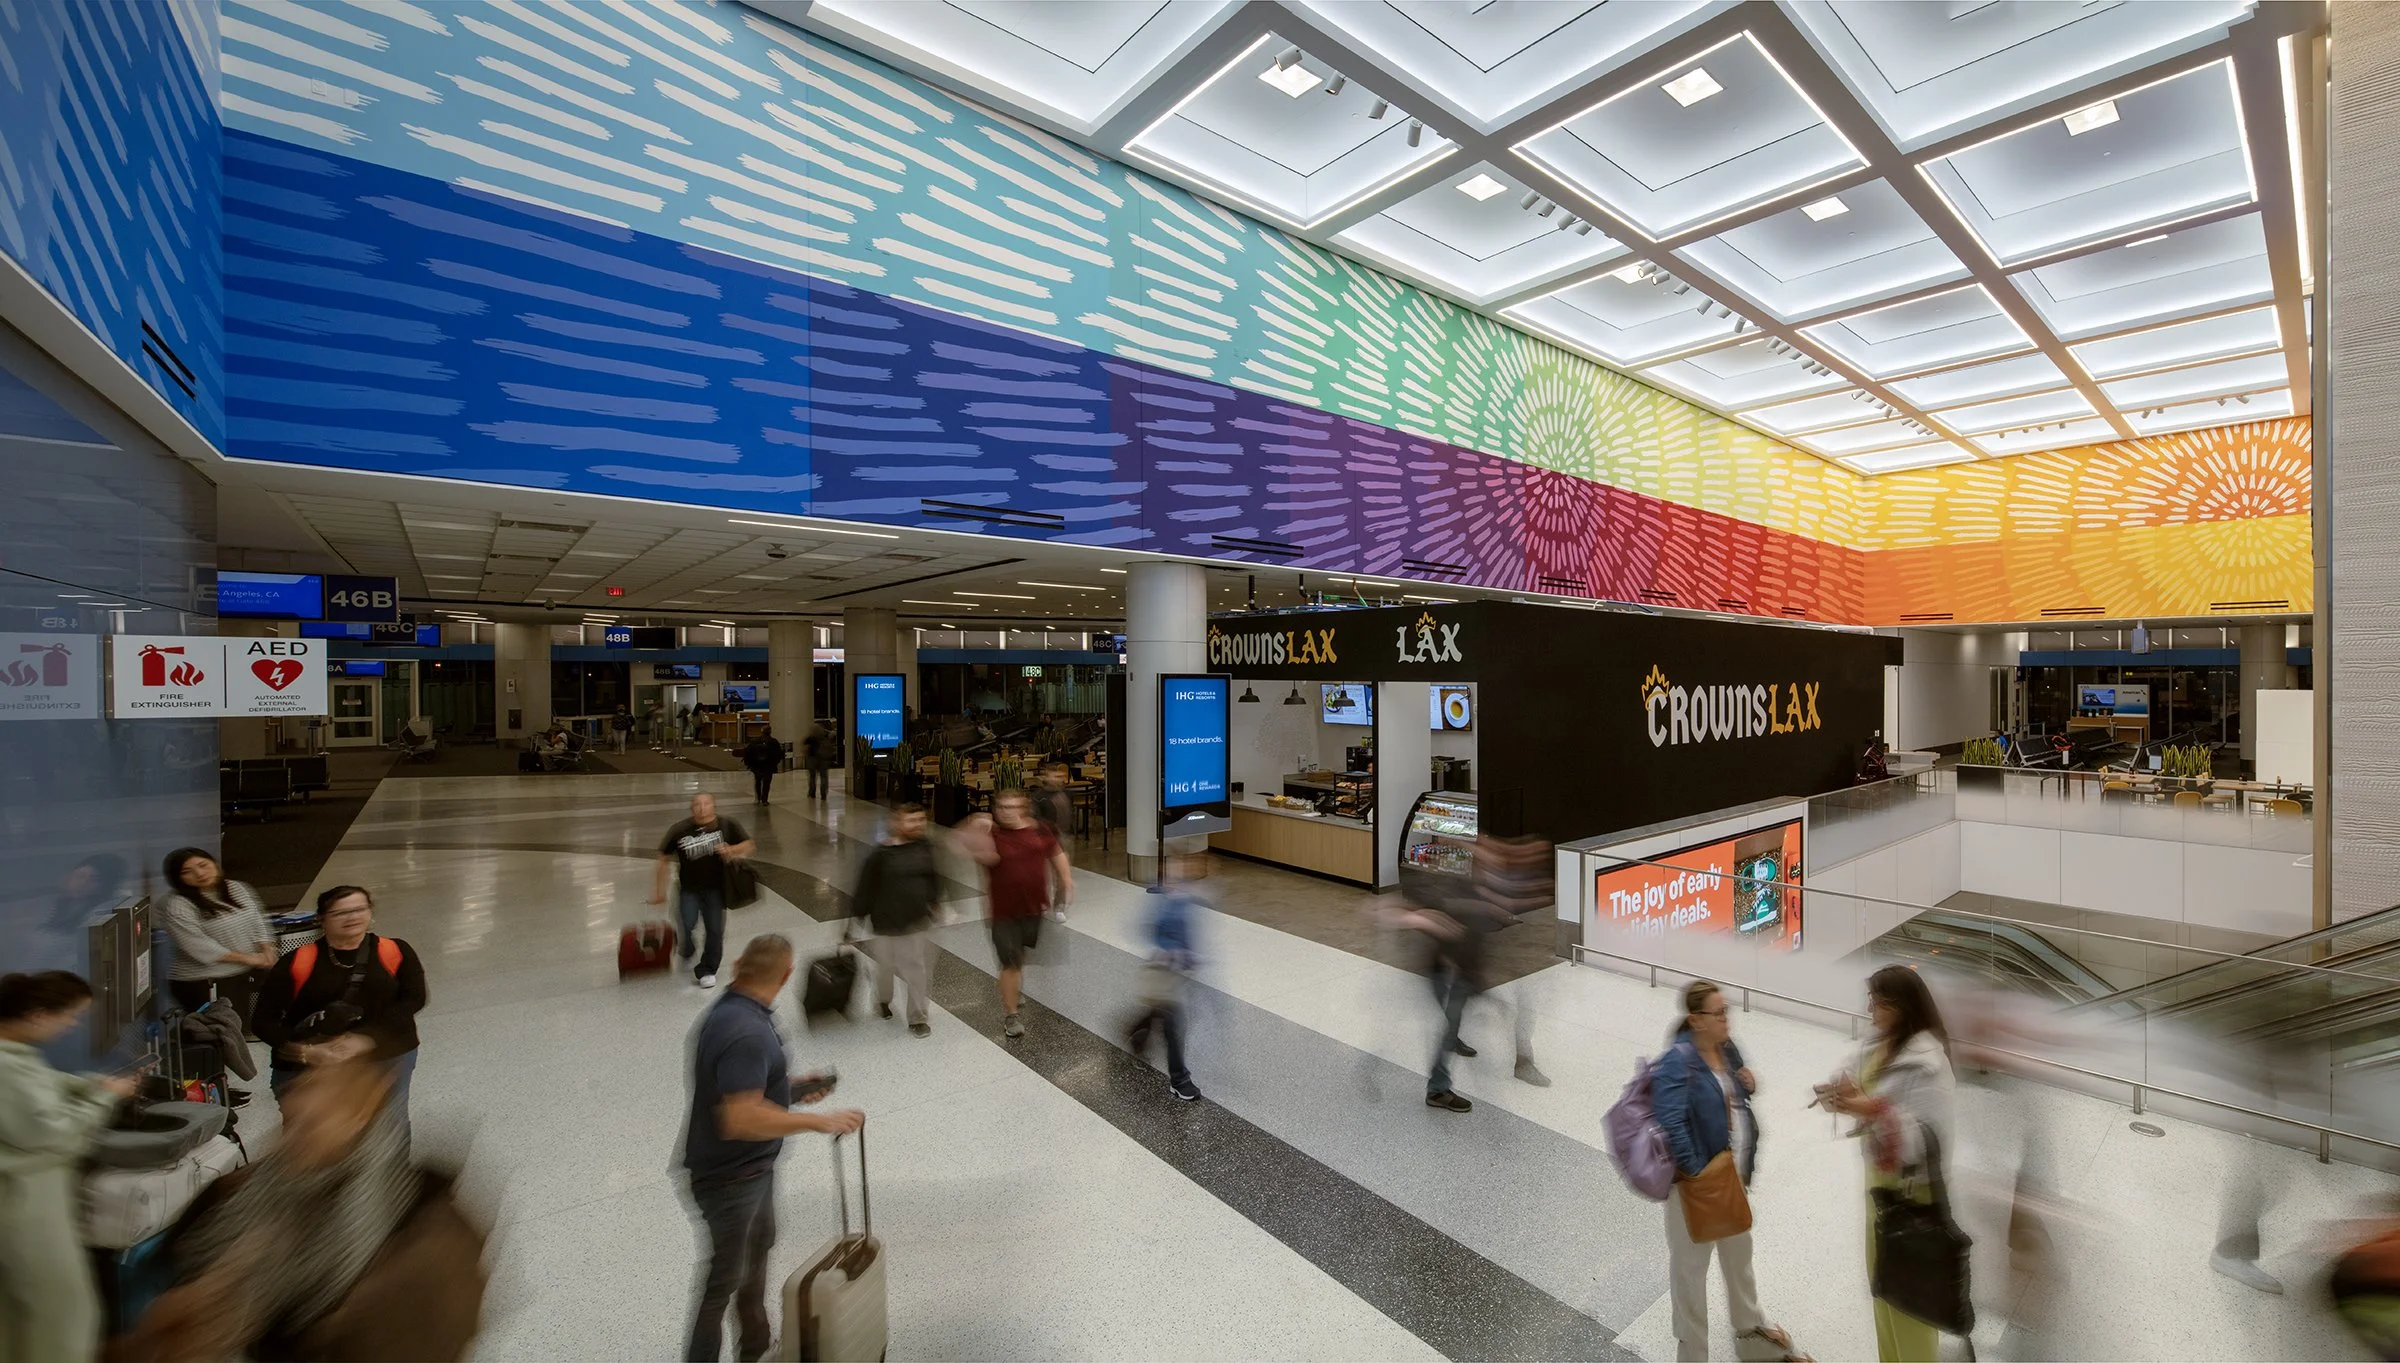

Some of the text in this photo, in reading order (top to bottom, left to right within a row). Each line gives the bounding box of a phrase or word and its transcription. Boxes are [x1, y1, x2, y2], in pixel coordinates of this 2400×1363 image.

[222, 589, 264, 599] Angeles,
[330, 590, 393, 608] 46B
[375, 622, 414, 634] 46C
[606, 633, 631, 643] 48B
[1396, 622, 1463, 664] LAX
[247, 641, 308, 656] AED
[1093, 640, 1112, 648] 48C
[327, 664, 343, 672] 8A
[1175, 691, 1195, 701] IHG
[131, 701, 212, 709] EXTINGUISHER
[1169, 736, 1223, 745] 18 hotel brands.
[1170, 782, 1189, 794] IHG
[1609, 863, 1722, 919] The joy of early
[1670, 897, 1712, 931] deals.
